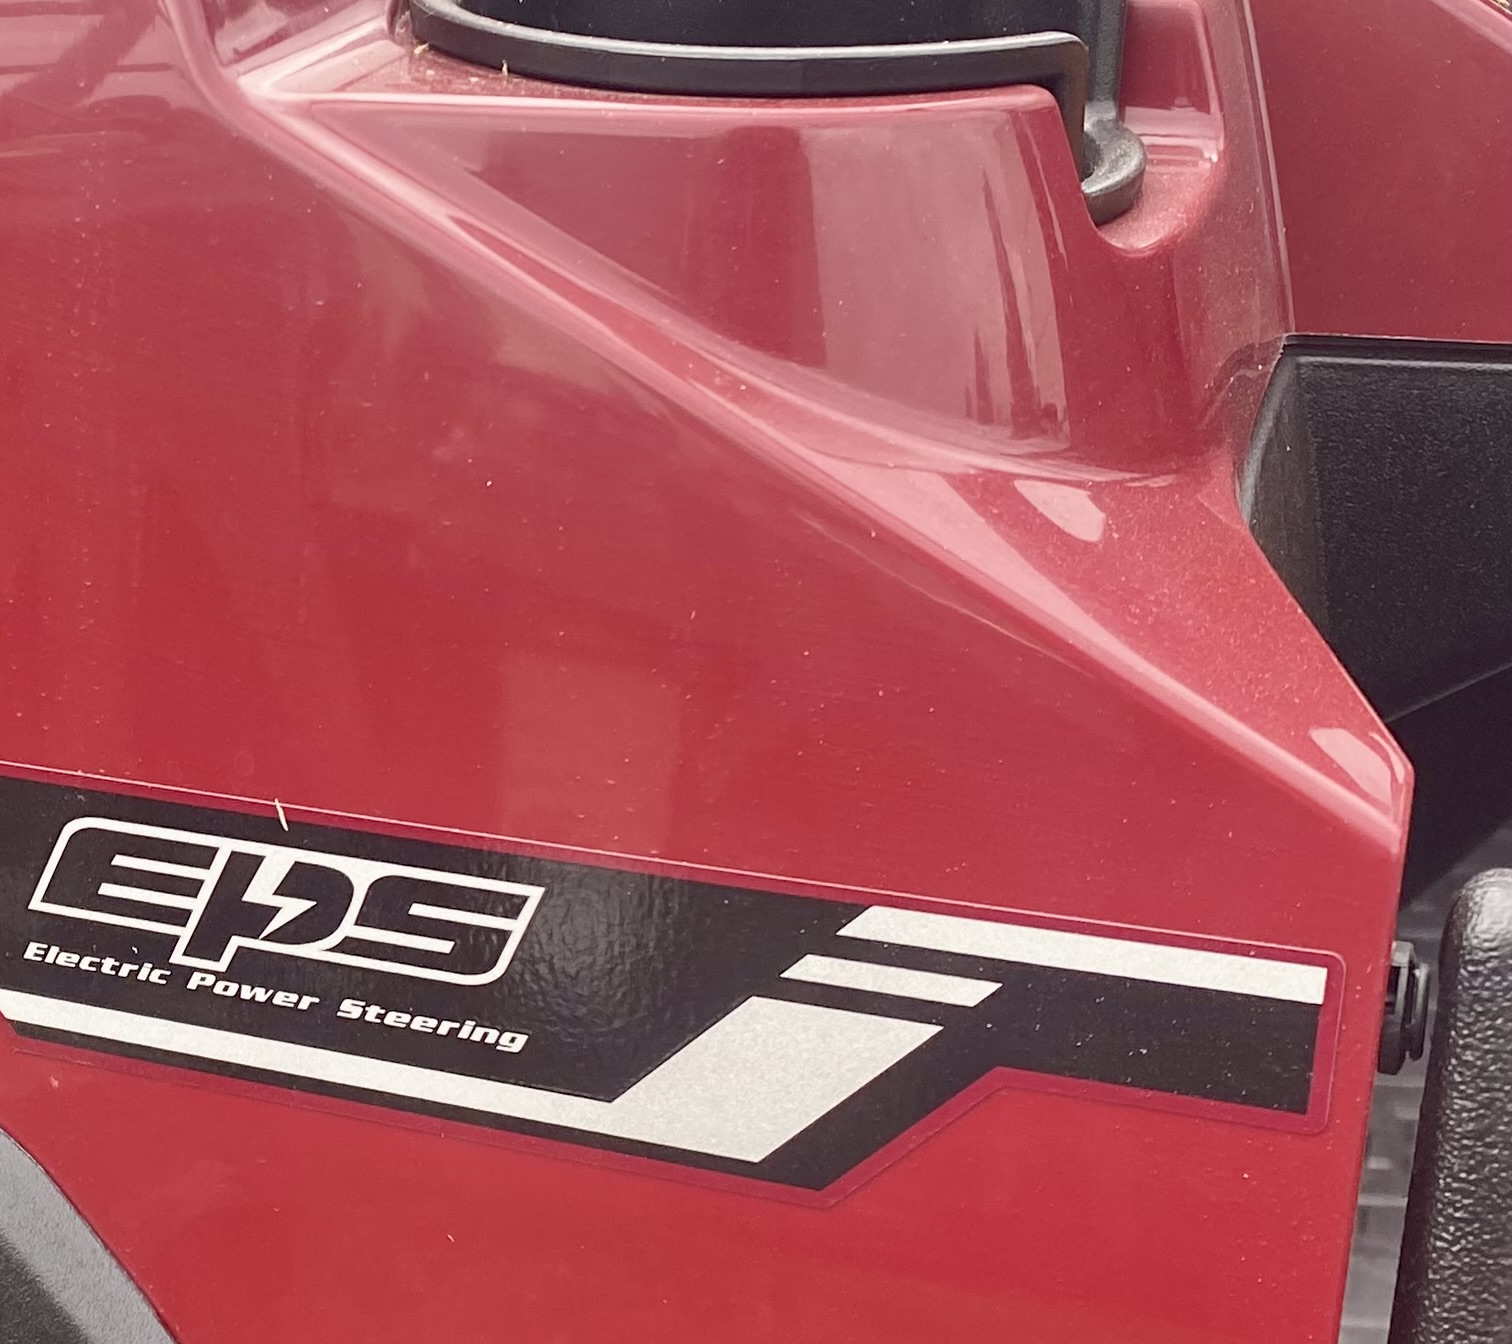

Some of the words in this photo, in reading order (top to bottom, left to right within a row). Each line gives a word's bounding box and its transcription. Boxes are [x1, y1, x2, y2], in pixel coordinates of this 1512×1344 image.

[27, 816, 546, 986] EPS
[23, 941, 170, 986] Electric
[186, 969, 320, 1012] Power
[337, 997, 530, 1054] Steering
